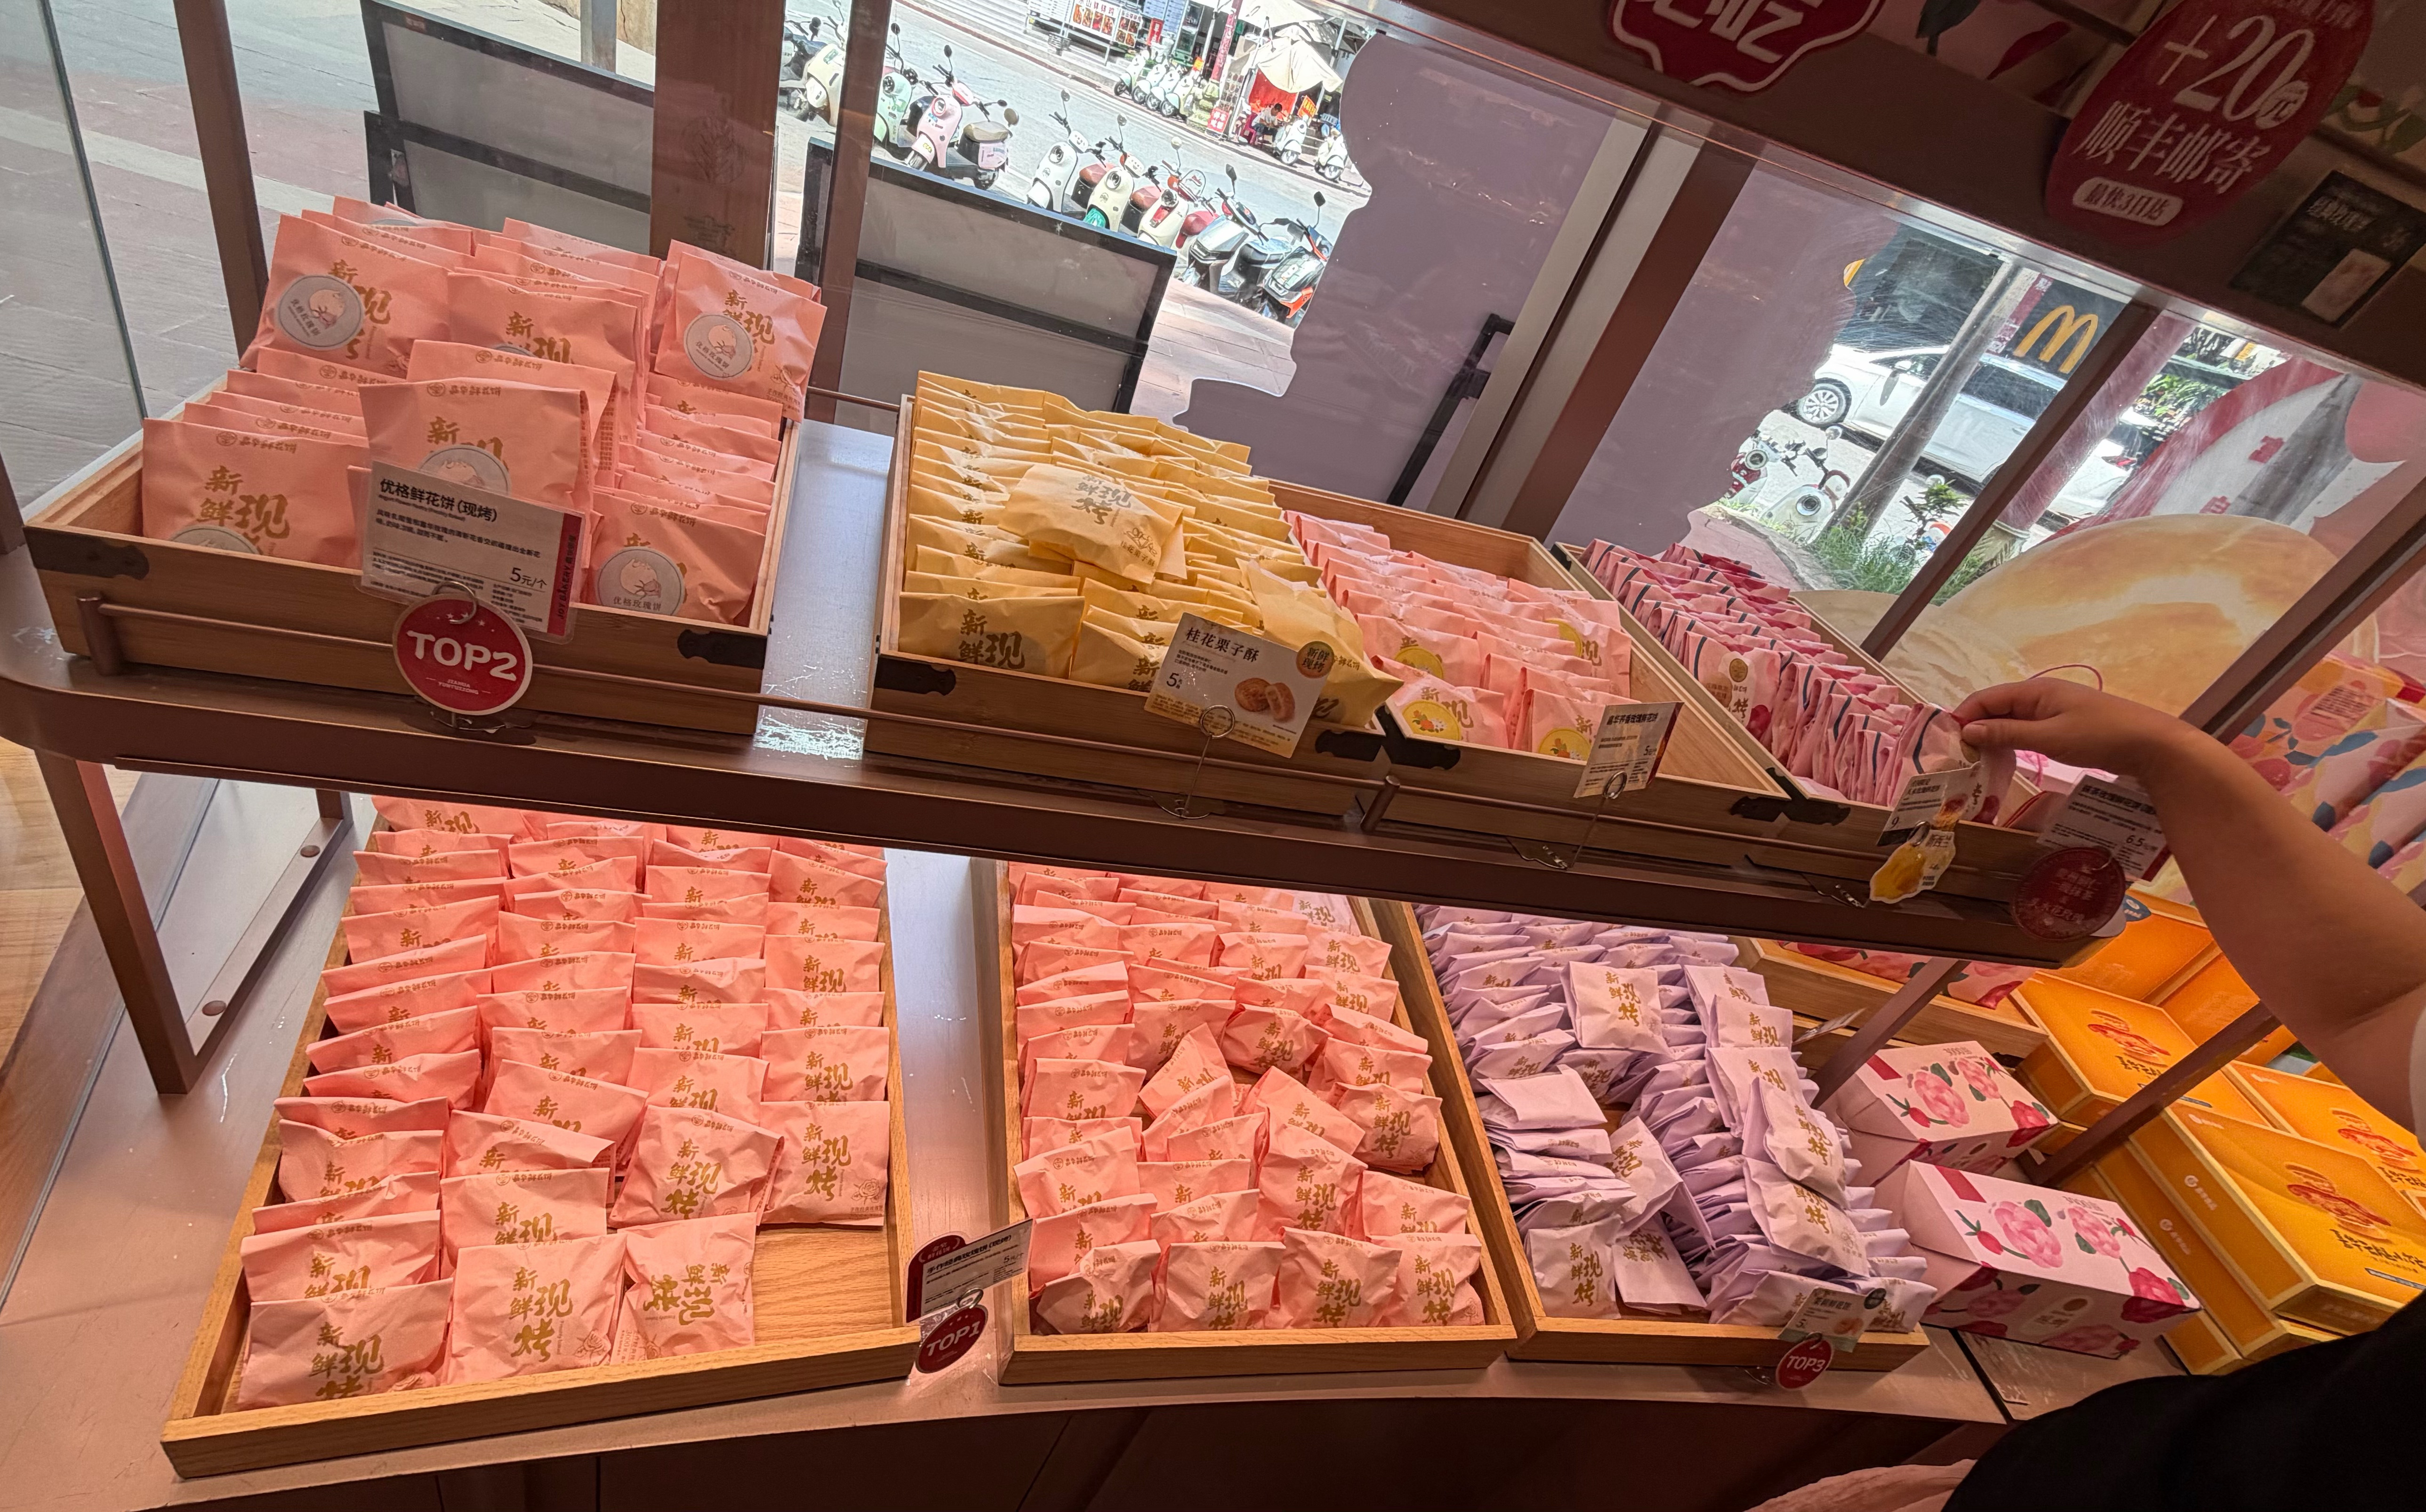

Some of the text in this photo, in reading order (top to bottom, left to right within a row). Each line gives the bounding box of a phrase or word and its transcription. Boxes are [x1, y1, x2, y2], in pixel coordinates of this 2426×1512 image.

[2071, 100, 2272, 195] 顺丰邮寄
[406, 630, 518, 681] TOP2
[1185, 627, 1260, 663] 桂花栗子酥
[1605, 971, 1641, 1027] 新鲜现烤
[1374, 1094, 1412, 1159] 新鲜现烤
[802, 1123, 852, 1201] 新鲜现烤
[1316, 1258, 1361, 1327] 新鲜现烤
[1414, 1255, 1456, 1326] 新鲜现烤
[1569, 1242, 1603, 1307] 新鲜现烤
[509, 1266, 573, 1362] 新鲜现烤
[926, 1320, 981, 1357] TOP1
[1787, 1355, 1825, 1372] TOP3
